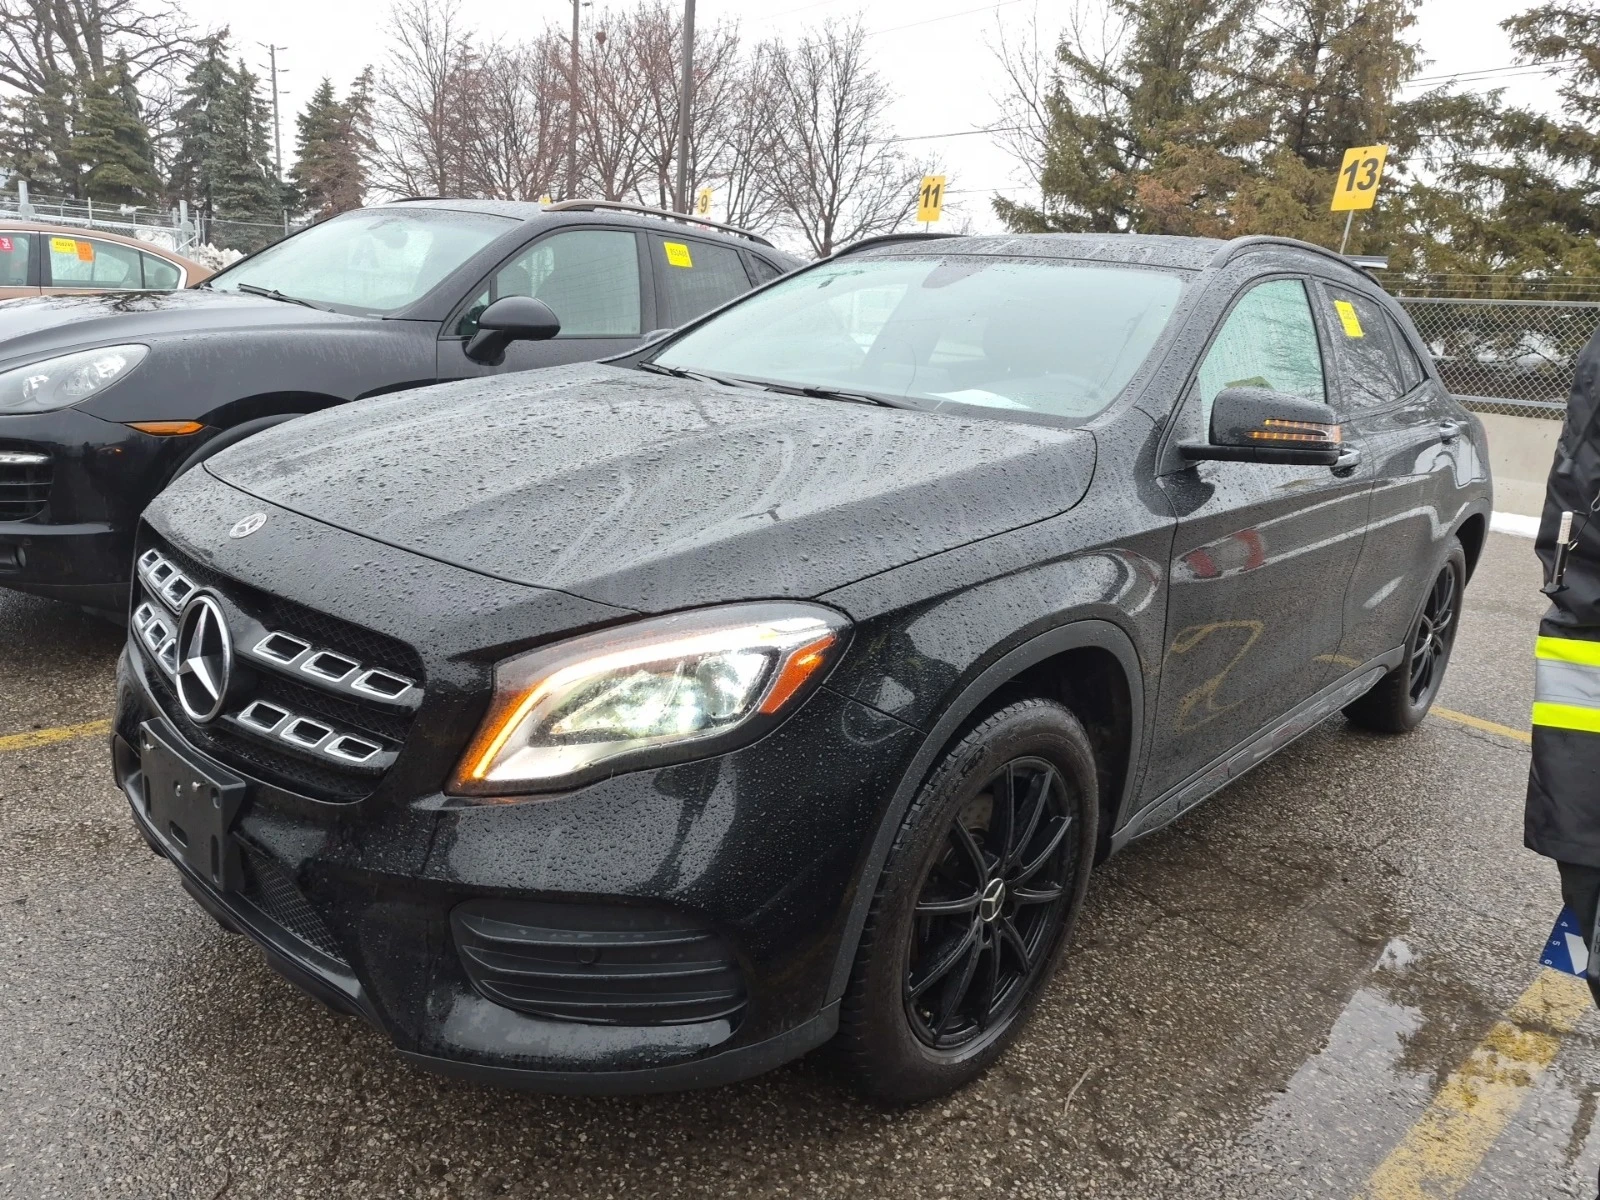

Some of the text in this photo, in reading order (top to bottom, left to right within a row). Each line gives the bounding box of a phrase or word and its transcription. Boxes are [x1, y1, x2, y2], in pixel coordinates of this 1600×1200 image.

[1343, 157, 1379, 192] 13
[700, 194, 708, 213] 9
[922, 183, 941, 208] 11
